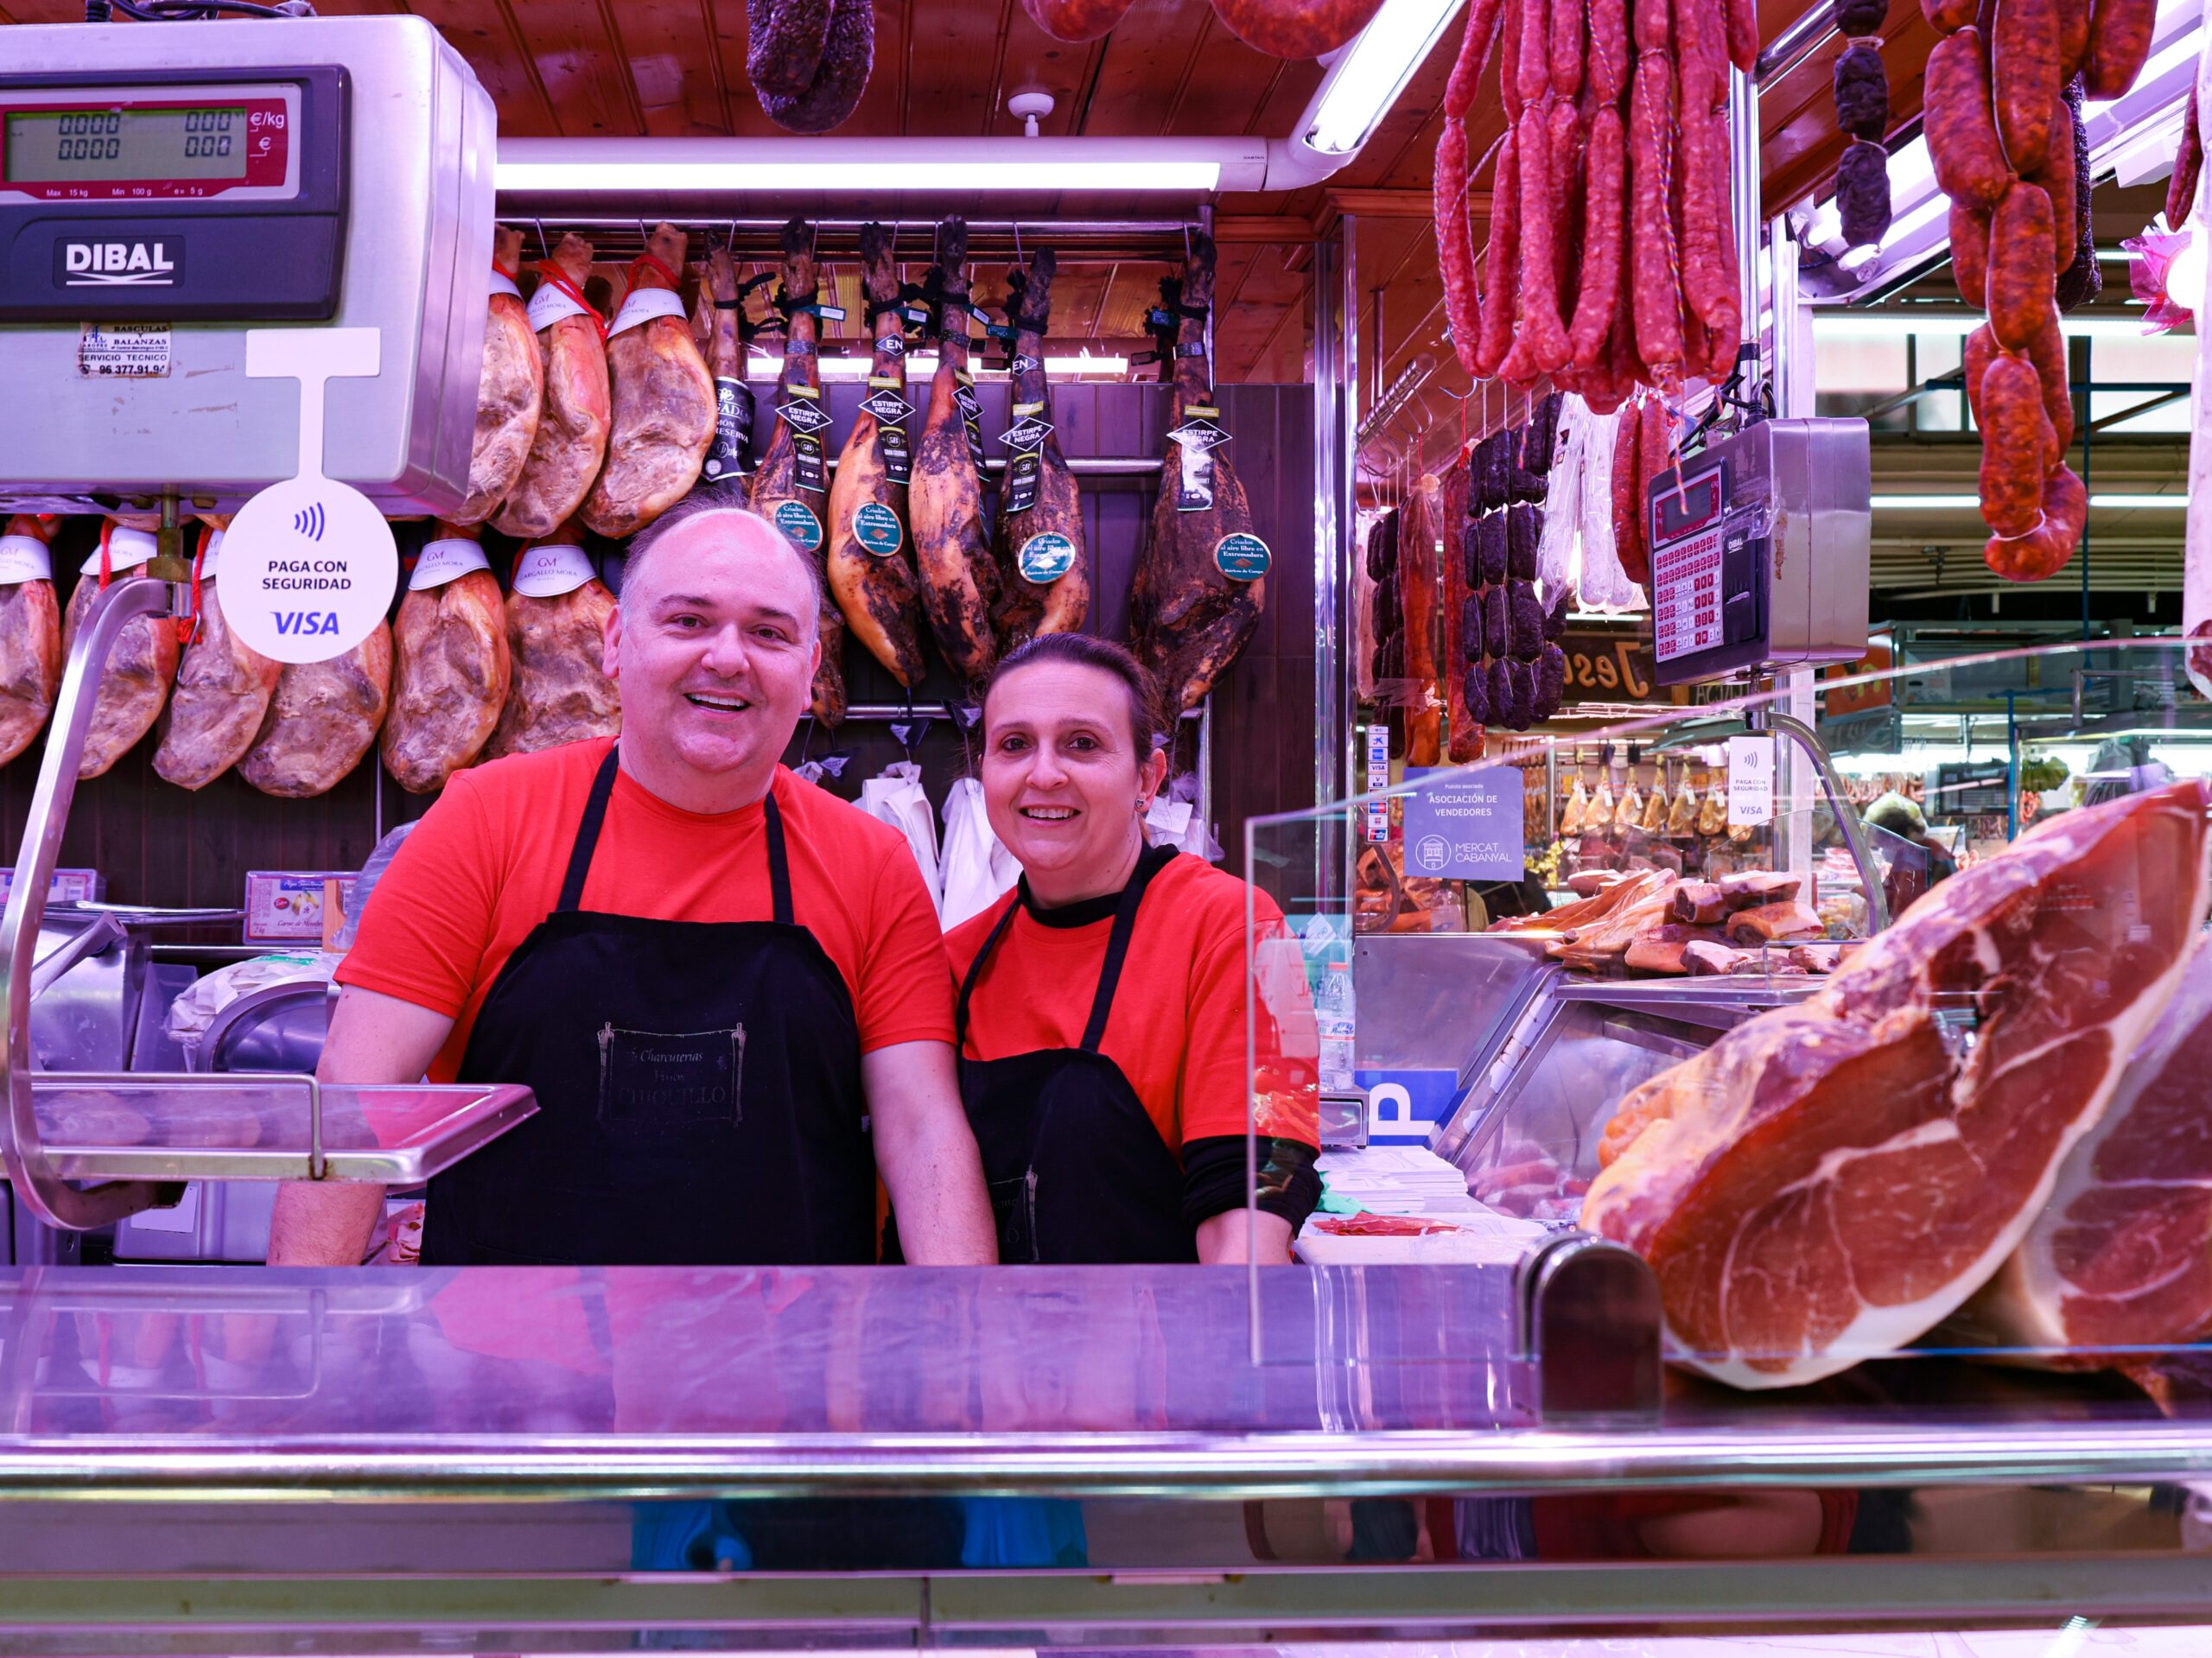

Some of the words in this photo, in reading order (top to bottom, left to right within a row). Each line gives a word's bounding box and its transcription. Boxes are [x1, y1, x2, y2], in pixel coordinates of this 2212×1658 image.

[250, 111, 285, 129] €/kg
[259, 137, 271, 150] €
[79, 189, 89, 198] kg
[67, 243, 174, 271] DIBAL
[887, 340, 903, 350] EN
[99, 365, 112, 374] 96
[1013, 359, 1028, 370] EN
[871, 400, 904, 409] ESTIRPE
[788, 407, 820, 419] ESTIRPE
[790, 414, 818, 425] NEGRA
[1012, 425, 1043, 437] ESTIRPE
[1014, 433, 1040, 443] NEGRA
[1729, 537, 1744, 549] DIBAL
[268, 561, 311, 572] PAGA
[314, 561, 347, 572] CON
[537, 557, 556, 568] GM
[556, 569, 578, 577] MORA
[262, 578, 352, 589] SEGURIDAD
[270, 612, 340, 635] VISA
[1429, 793, 1484, 804] ASOCIACIÓN
[1486, 795, 1497, 804] DE
[1434, 808, 1492, 816] VENDEDORES
[1739, 806, 1763, 815] VISA
[1455, 843, 1499, 852] MERCAT
[1455, 853, 1513, 862] CABANYAL
[1368, 1082, 1435, 1136] P
